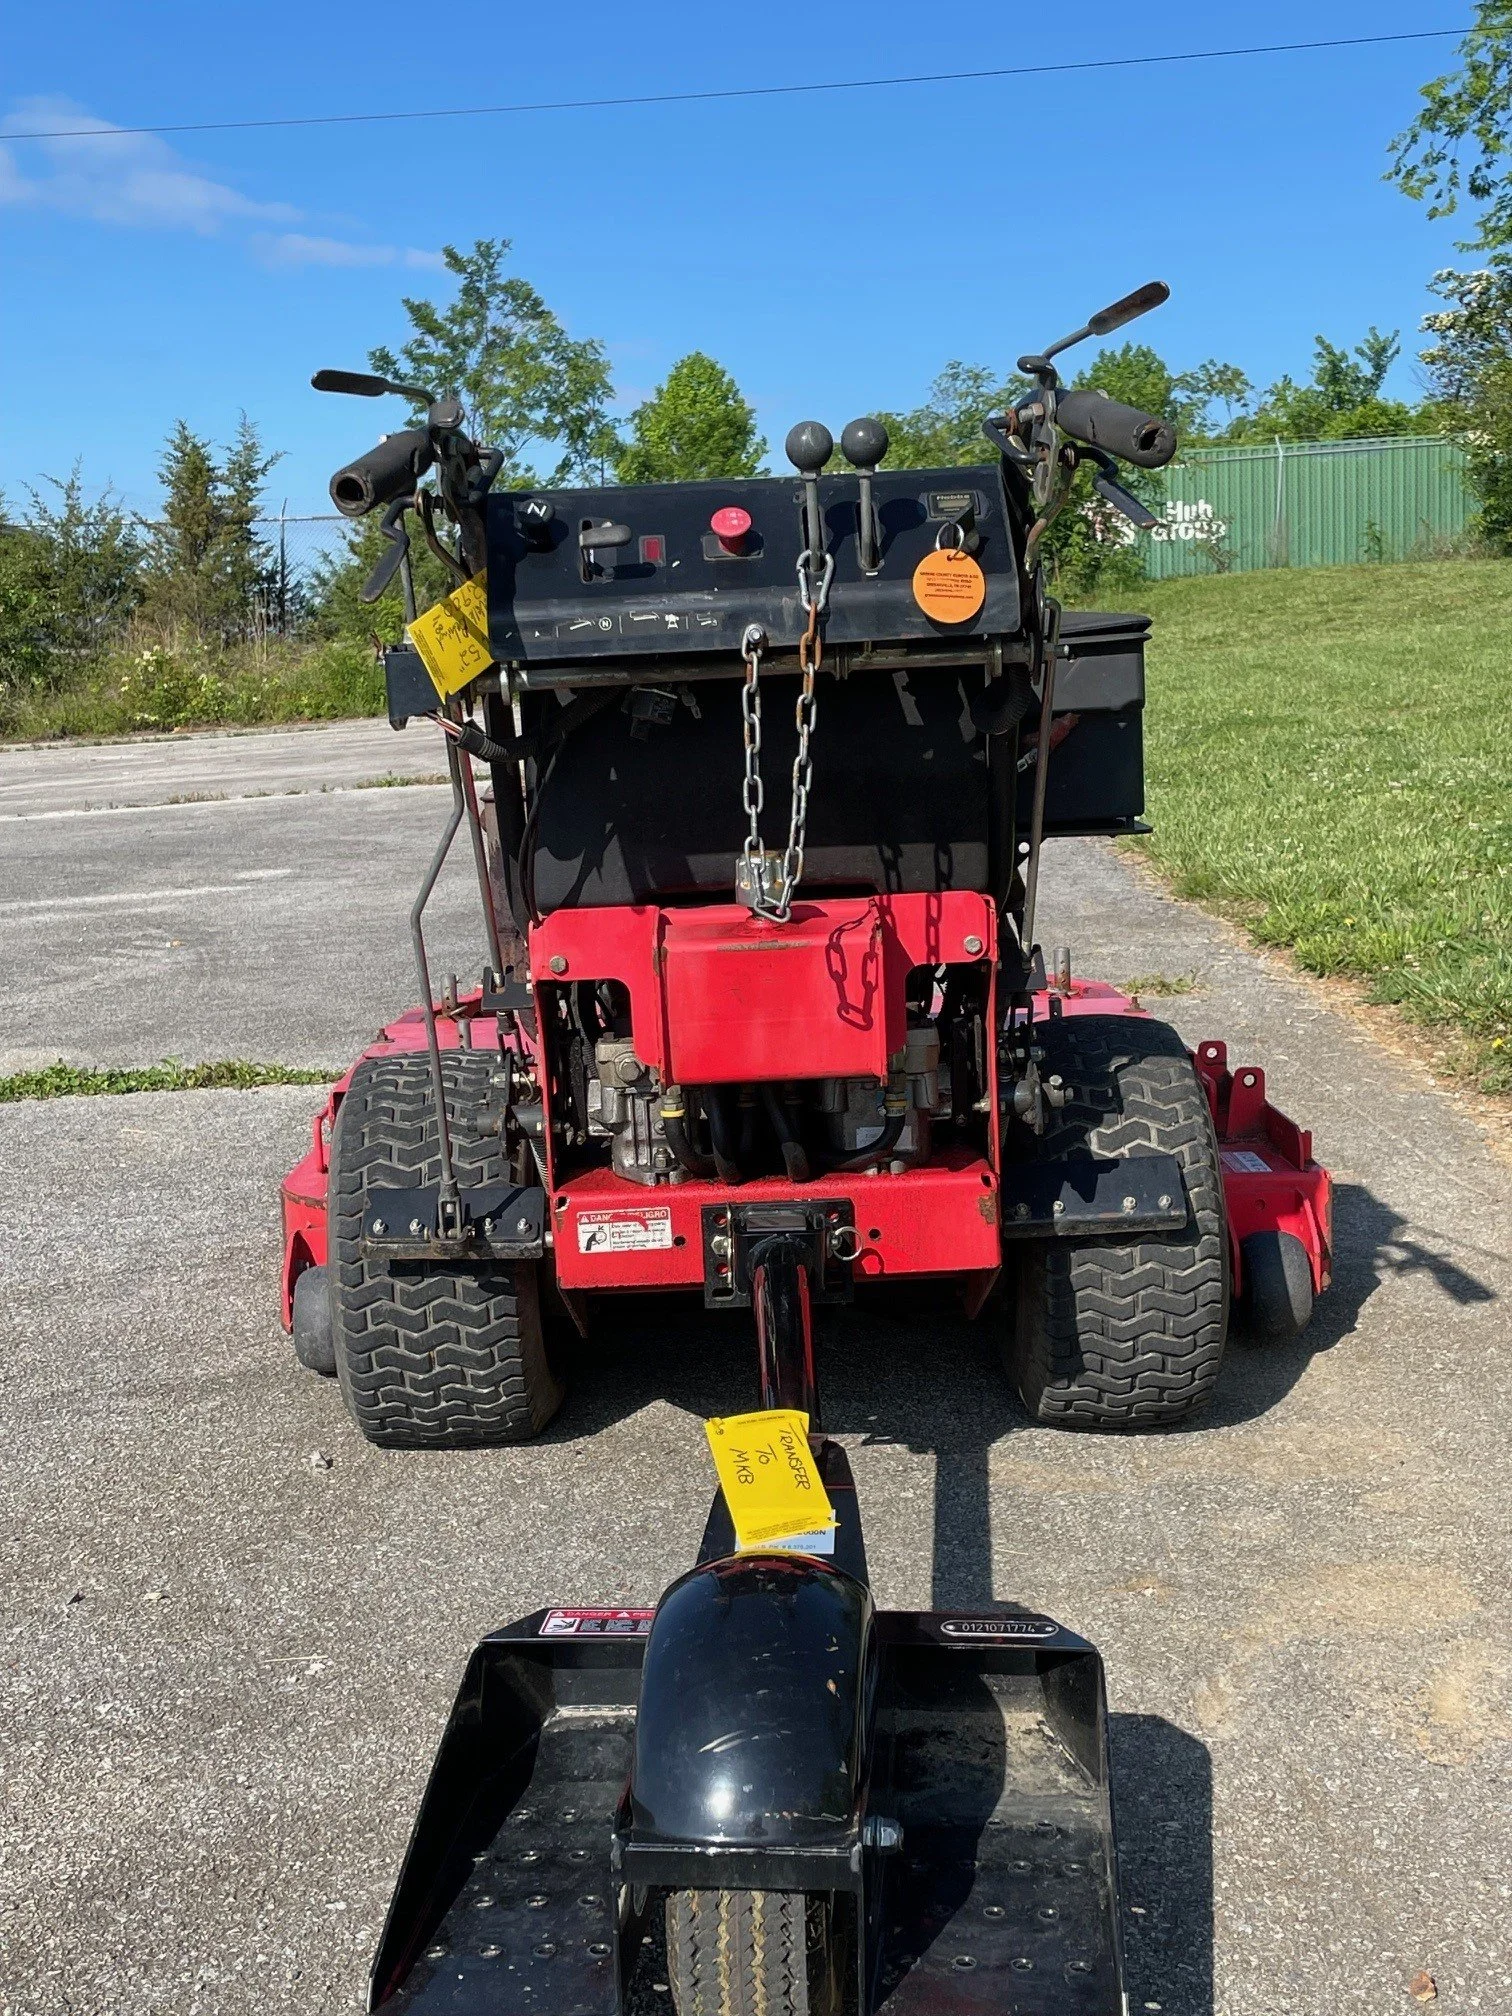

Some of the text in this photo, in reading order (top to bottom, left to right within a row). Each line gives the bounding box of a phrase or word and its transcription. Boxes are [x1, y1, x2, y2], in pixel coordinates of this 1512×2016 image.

[1166, 498, 1213, 521] Hub
[729, 1448, 755, 1485] MKB
[779, 1422, 811, 1491] TRANSFER
[962, 1622, 1036, 1633] 0121071774
